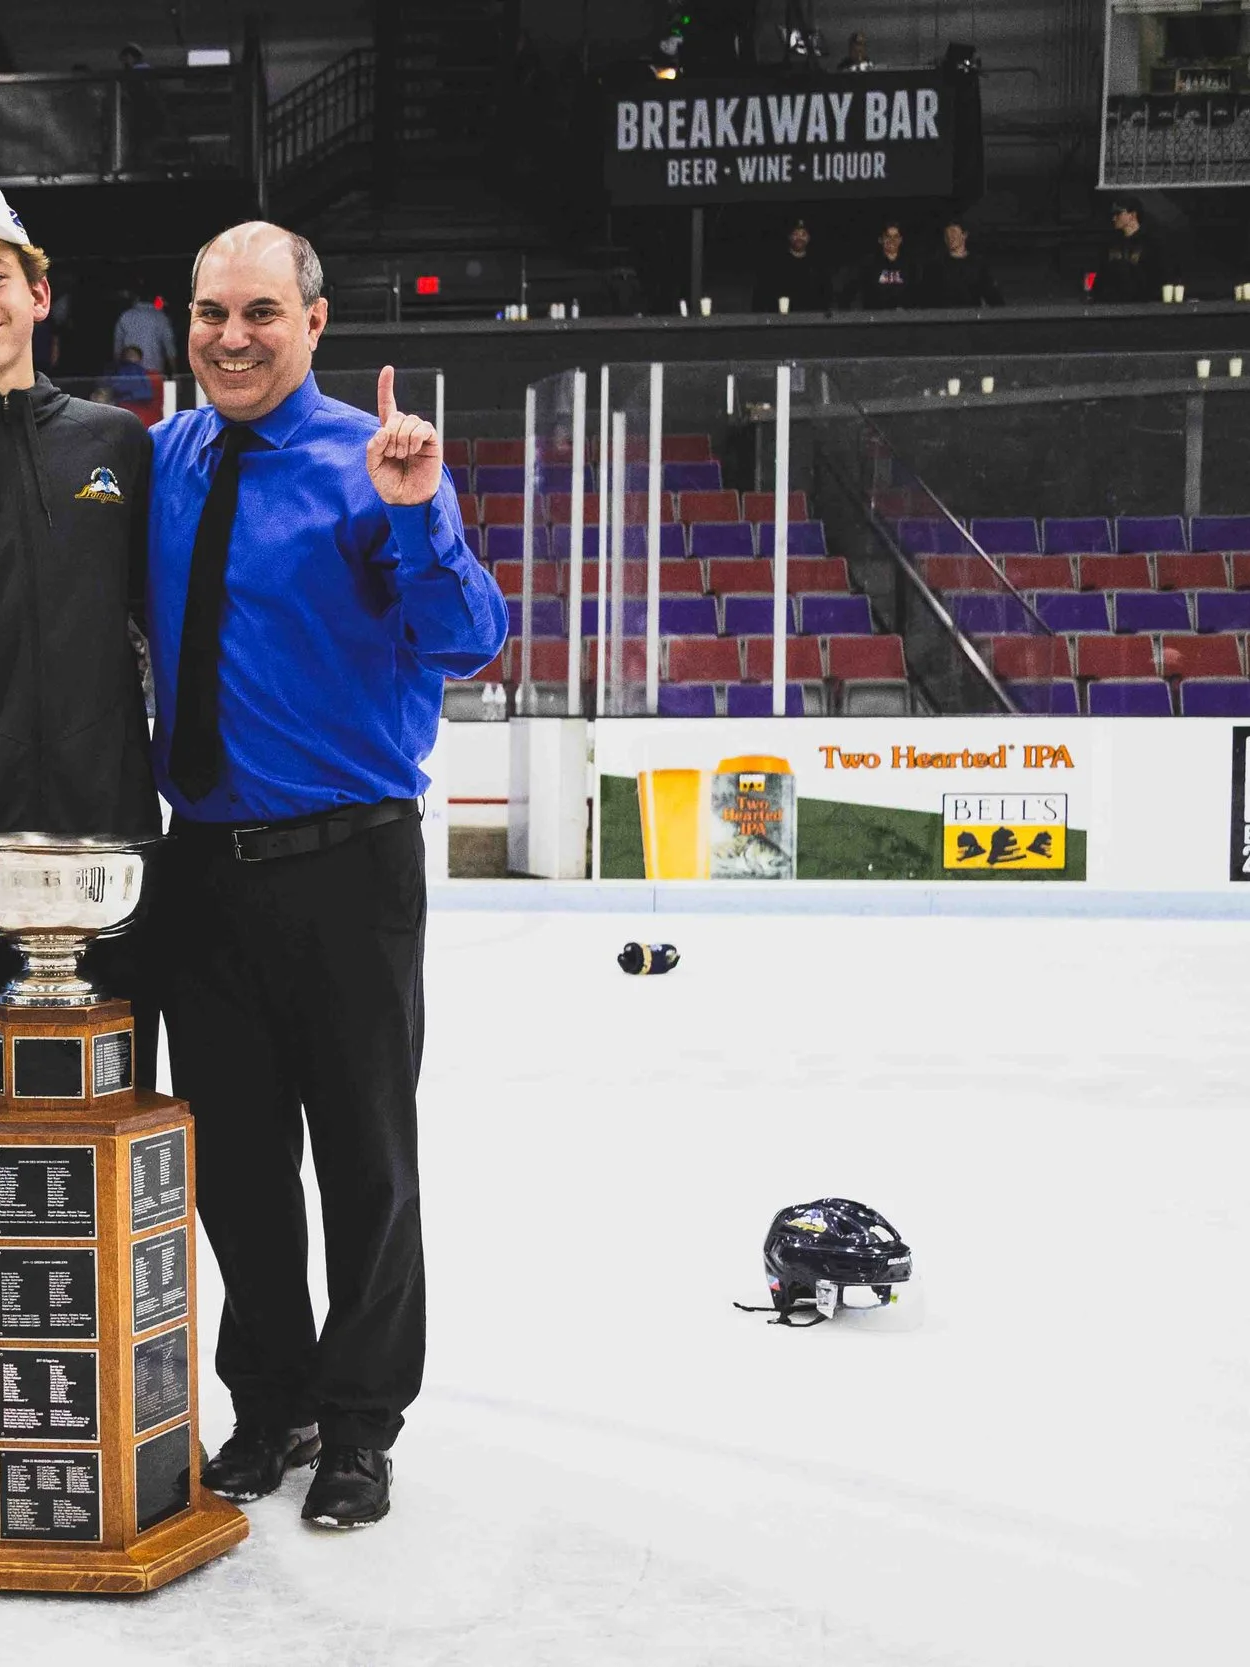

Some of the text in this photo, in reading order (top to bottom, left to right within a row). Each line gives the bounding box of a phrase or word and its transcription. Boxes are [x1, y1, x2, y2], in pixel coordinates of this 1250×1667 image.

[617, 89, 939, 150] BREAKAWAY BAR
[667, 152, 887, 186] BEER WINE LIQUOR
[819, 745, 1075, 769] Two Hearted IPA
[722, 808, 783, 821] Hearted
[737, 796, 769, 810] Two
[954, 798, 1059, 821] BELL'S
[740, 822, 767, 836] IPA
